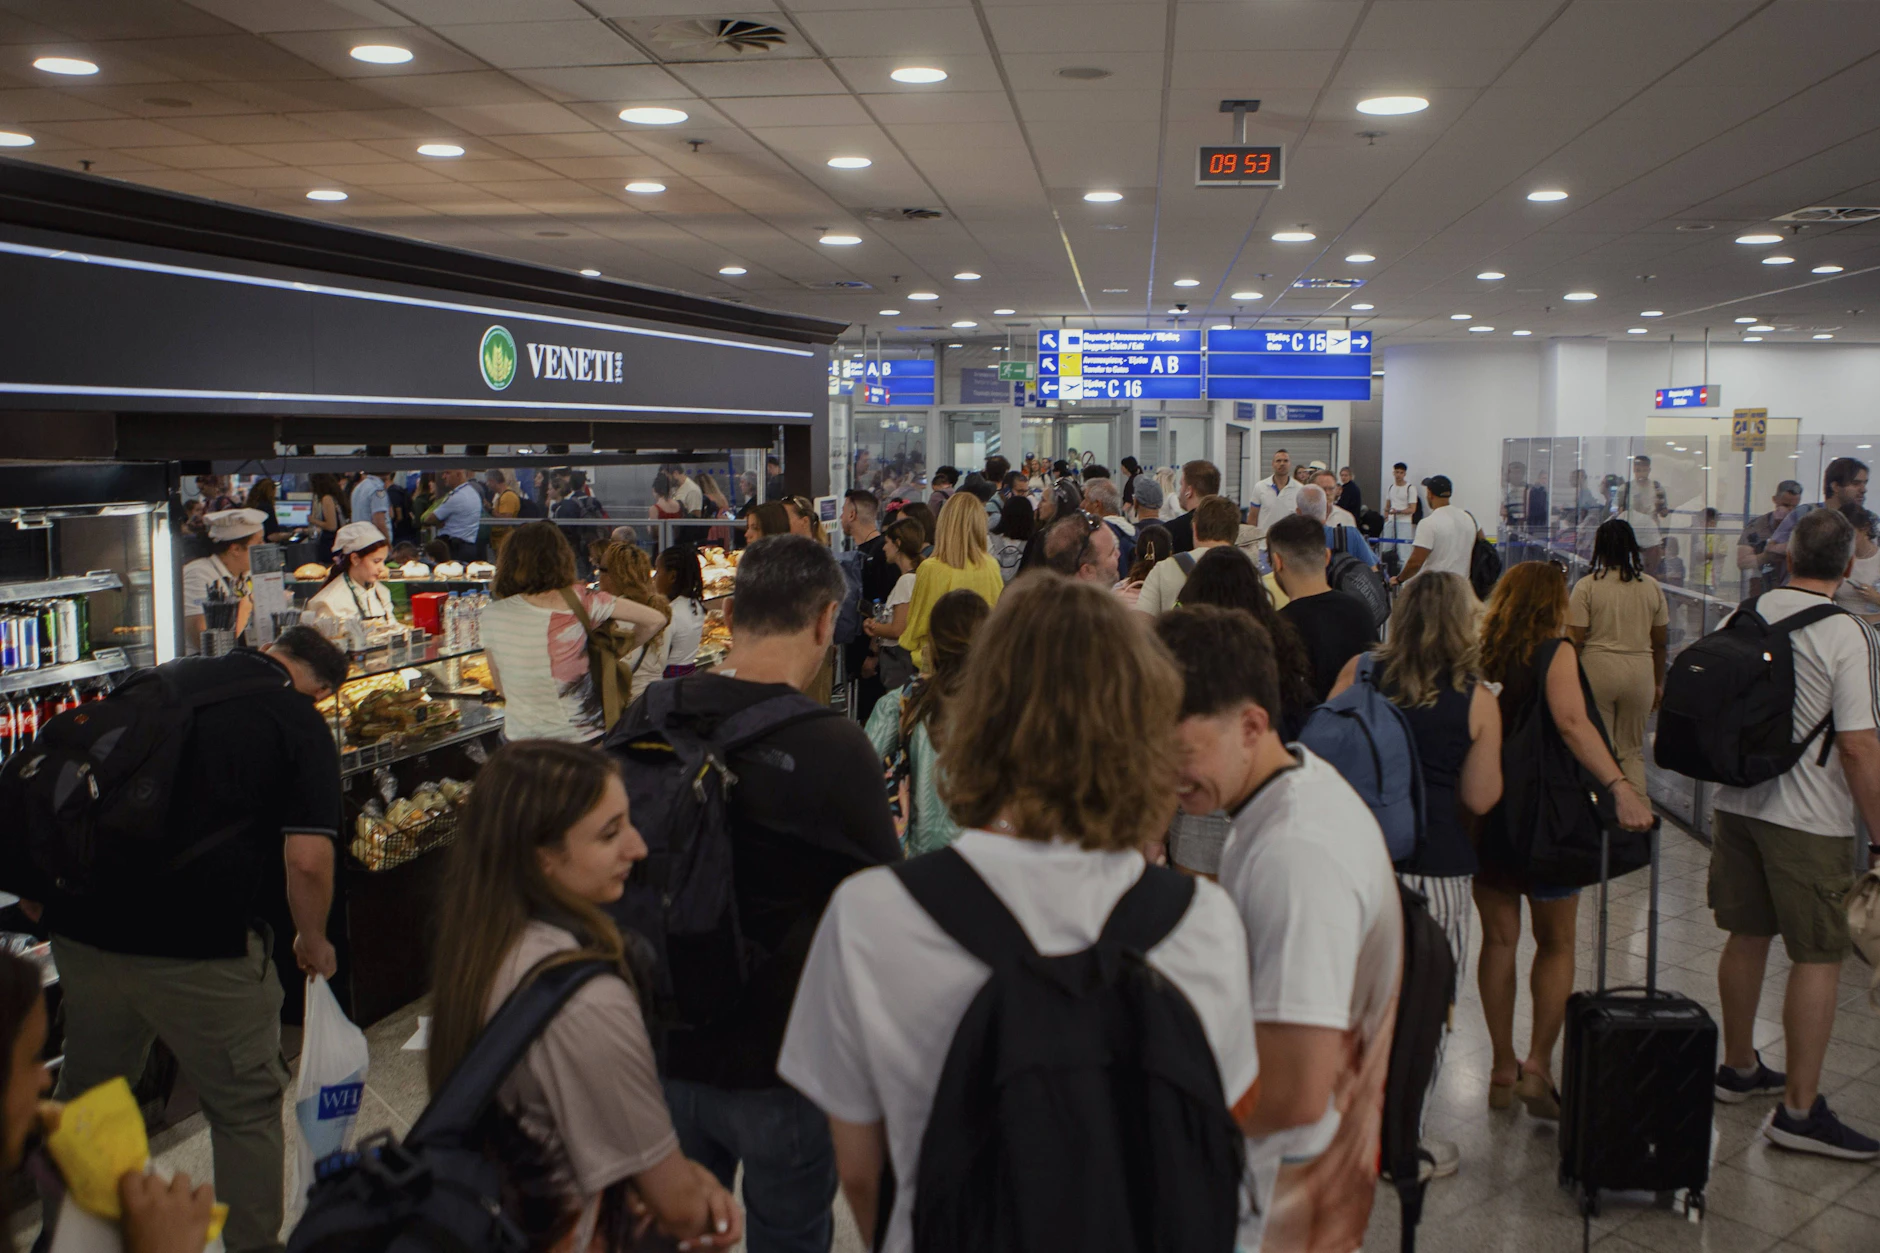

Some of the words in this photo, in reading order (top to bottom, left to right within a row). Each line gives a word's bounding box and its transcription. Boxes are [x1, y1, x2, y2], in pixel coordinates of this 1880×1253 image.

[1209, 153, 1237, 174] 09
[1244, 153, 1271, 174] 53
[1291, 332, 1304, 351] C
[1308, 333, 1326, 351] 15
[526, 343, 614, 383] VENETI
[882, 362, 891, 375] B
[1150, 356, 1164, 373] A
[1167, 356, 1179, 373] B
[1107, 379, 1119, 398] C
[1124, 379, 1142, 398] 16
